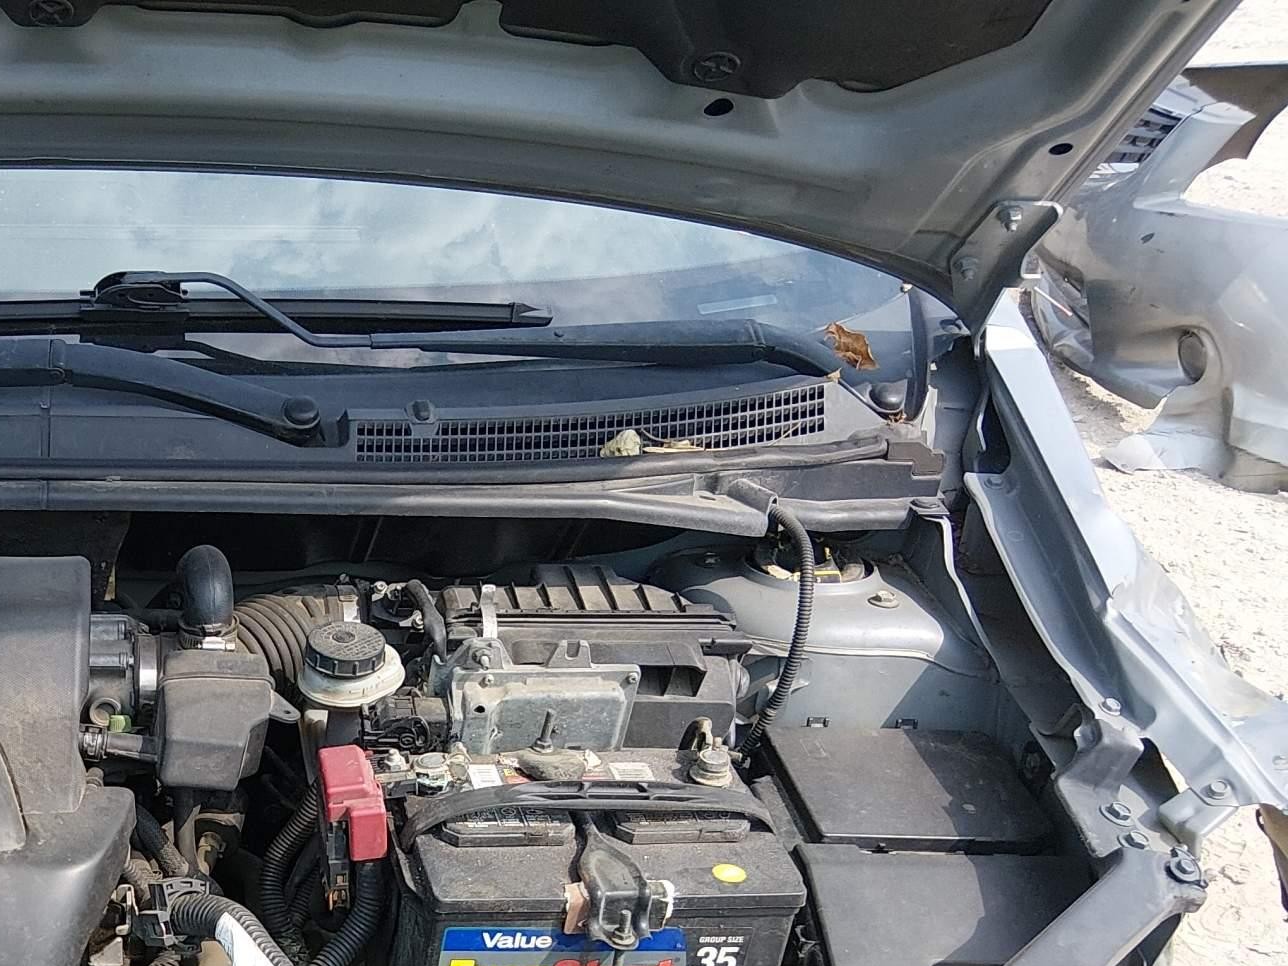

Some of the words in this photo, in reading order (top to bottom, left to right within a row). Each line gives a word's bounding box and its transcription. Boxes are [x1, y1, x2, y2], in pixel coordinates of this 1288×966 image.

[481, 932, 553, 949] Value
[699, 936, 726, 944] GROUP
[727, 936, 744, 944] SIZE
